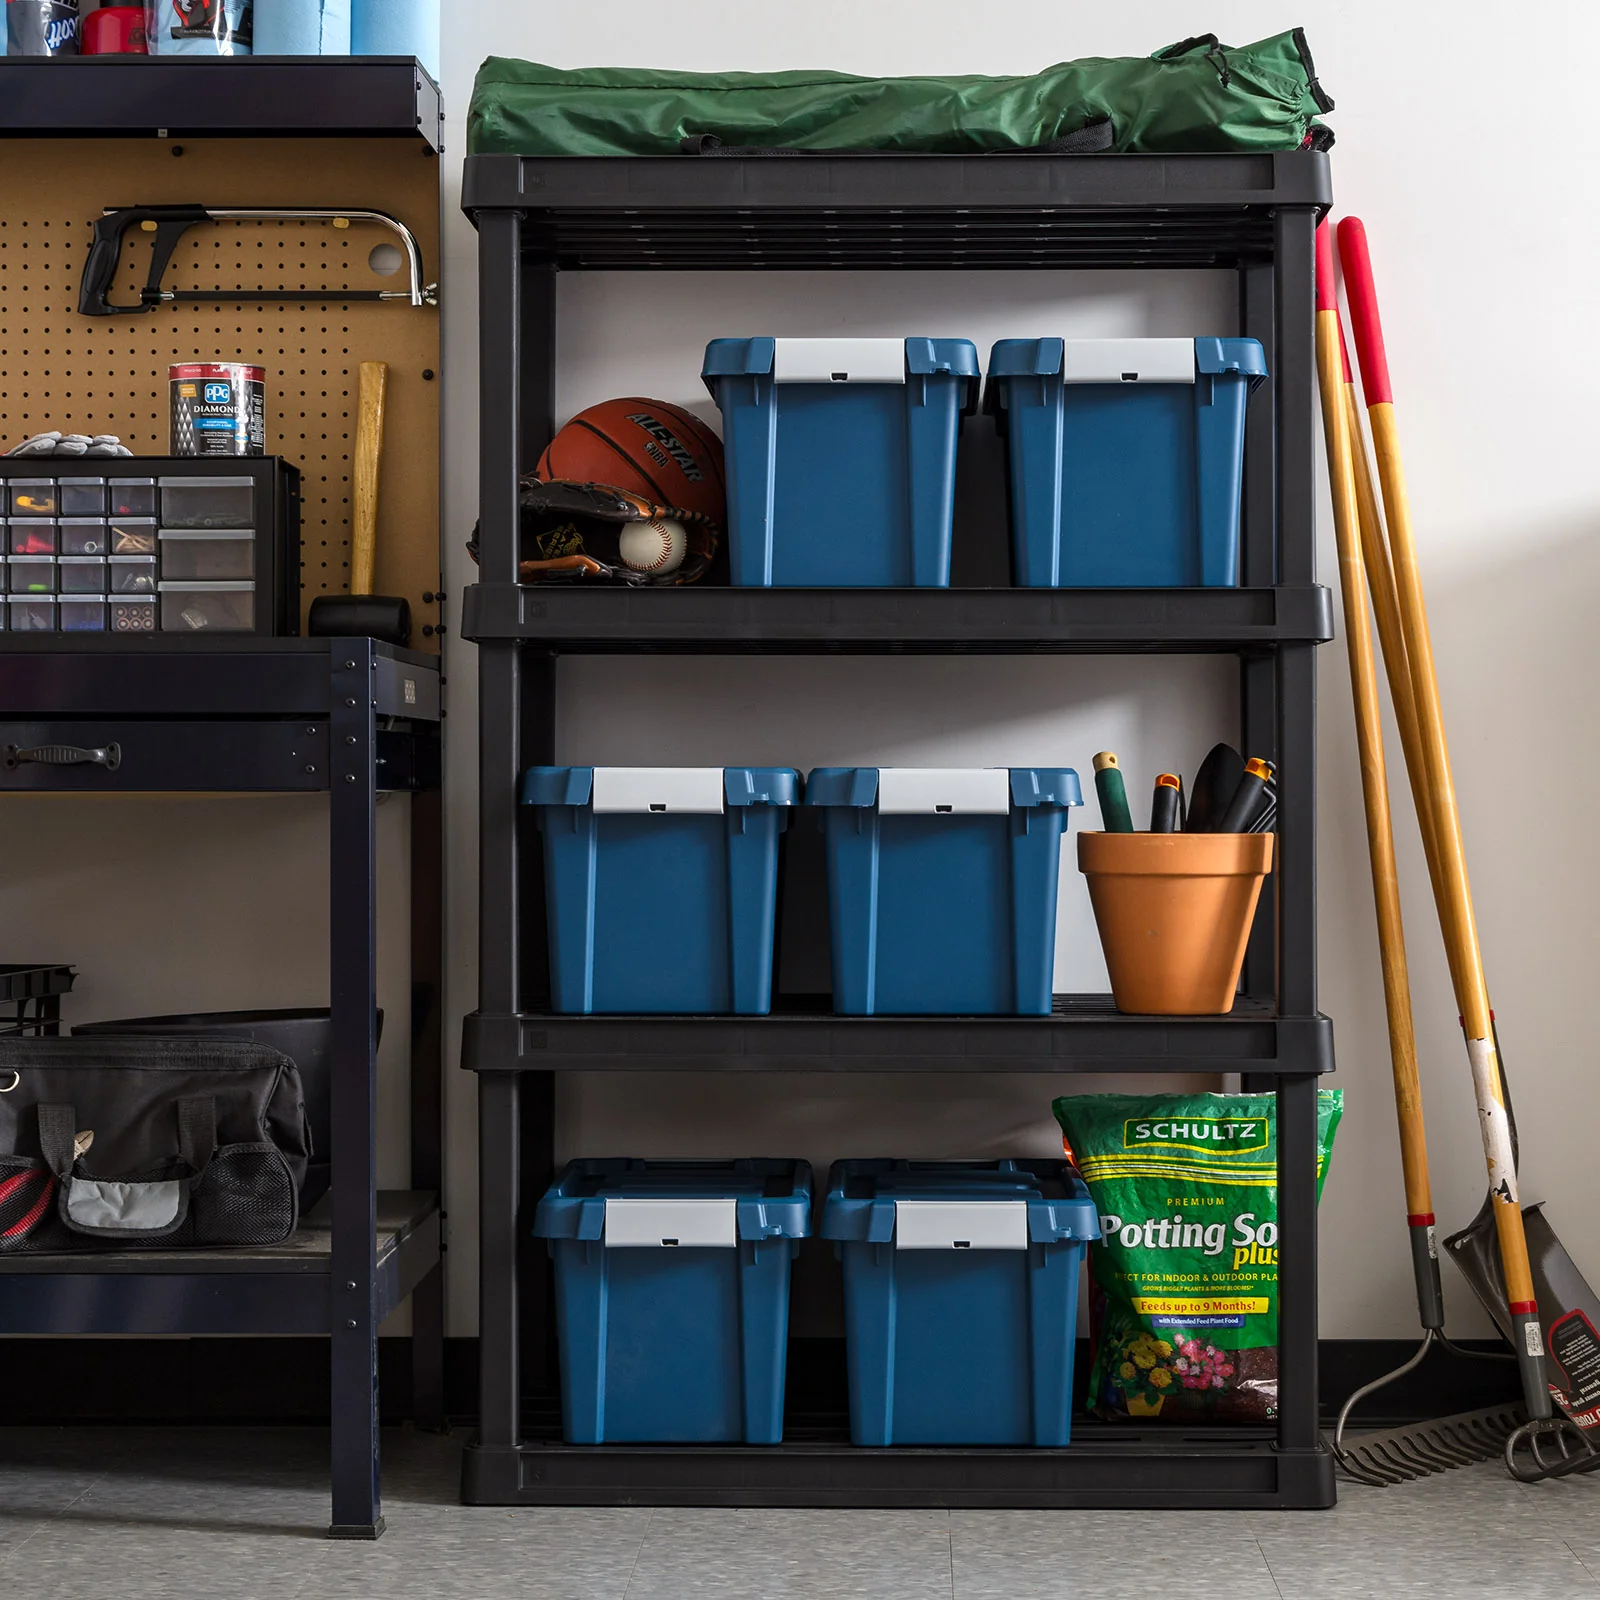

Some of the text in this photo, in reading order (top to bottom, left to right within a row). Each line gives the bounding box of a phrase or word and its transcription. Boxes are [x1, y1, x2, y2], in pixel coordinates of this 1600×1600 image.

[206, 385, 228, 401] PPG
[193, 405, 241, 413] DIAMOND
[624, 412, 703, 483] ALL-STAR
[646, 441, 670, 469] NBA
[1135, 1123, 1257, 1140] SCHULTZ
[1166, 1197, 1225, 1206] PREMIUM
[1099, 1212, 1278, 1256] Potting So
[1141, 1273, 1160, 1281] FOR
[1162, 1273, 1200, 1282] INDOOR
[1202, 1273, 1209, 1281] &
[1211, 1272, 1258, 1281] OUTDOOR
[1260, 1272, 1278, 1281] PLA
[1141, 1301, 1256, 1313] Feeds up to 9 Months!
[1171, 1317, 1196, 1325] Extended
